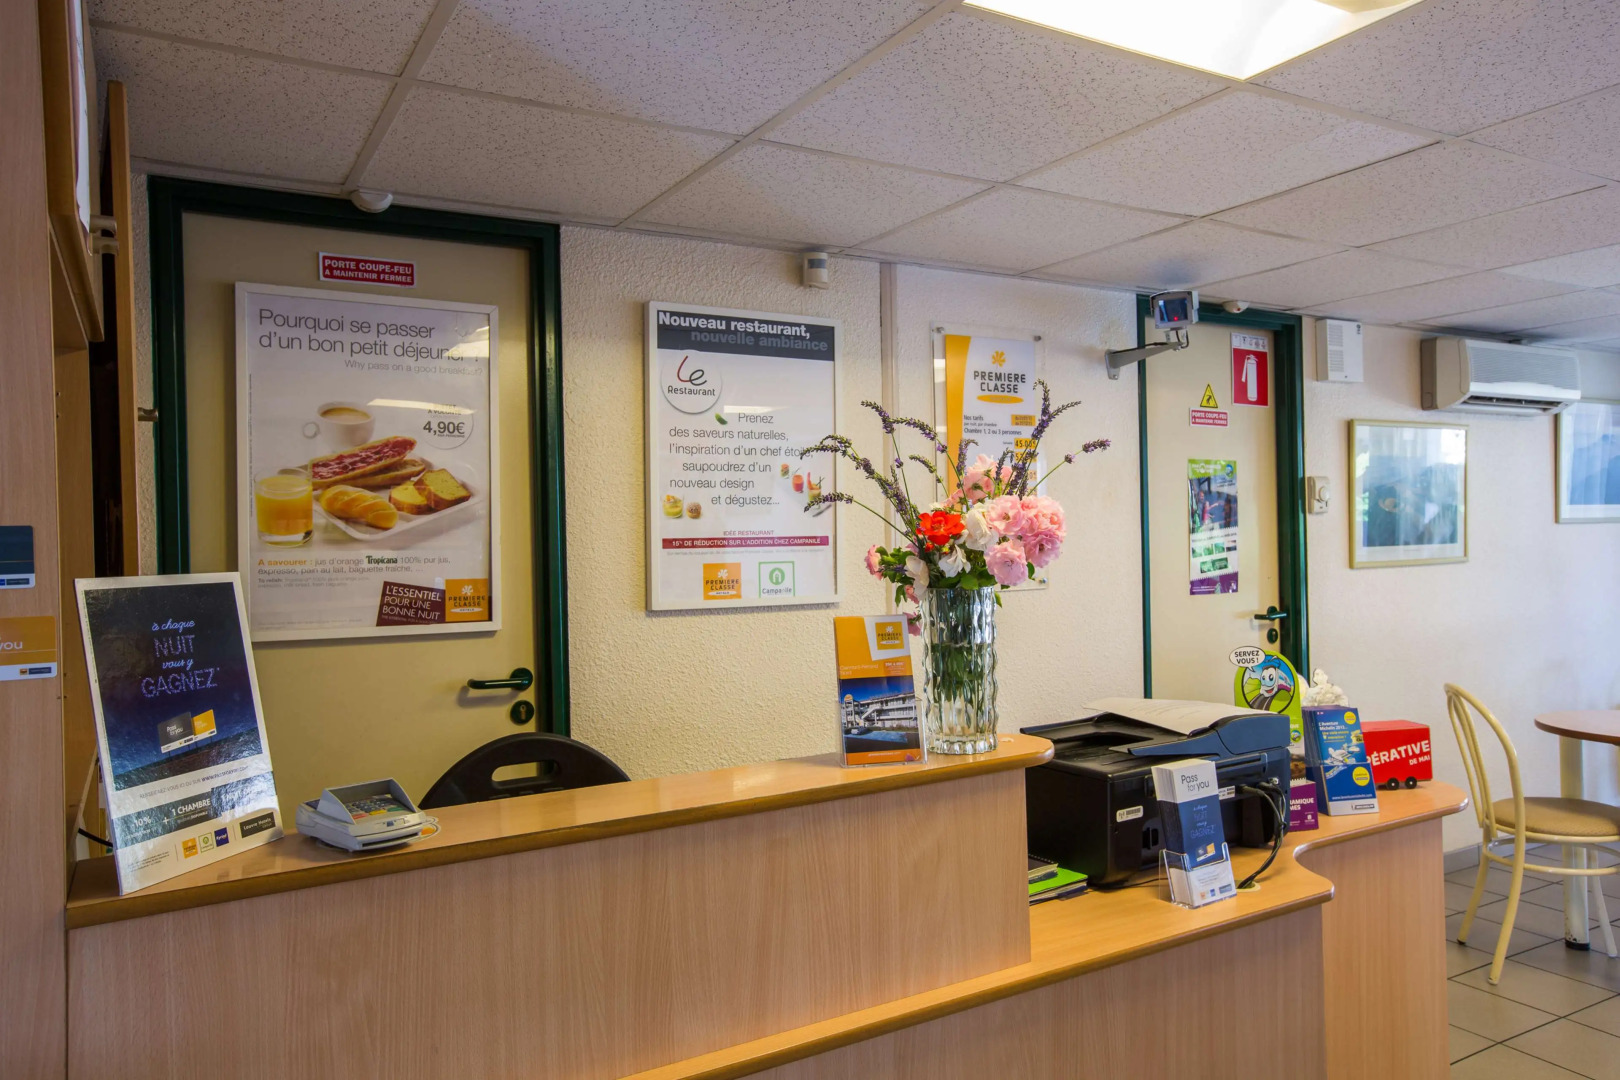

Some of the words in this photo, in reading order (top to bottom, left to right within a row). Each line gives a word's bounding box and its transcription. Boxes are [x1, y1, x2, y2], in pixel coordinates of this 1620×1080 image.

[324, 259, 356, 269] PORTE
[359, 263, 412, 274] COUPE-FEU
[333, 270, 378, 280] MAINTENIR
[258, 308, 344, 334] Pourquoi
[350, 319, 371, 334] se
[376, 322, 435, 339] passer
[658, 312, 726, 330] Nouveau
[730, 320, 810, 340] restaurant,
[258, 332, 302, 350] d'un
[308, 334, 344, 353] bon
[350, 340, 388, 358] petit
[690, 330, 755, 346] nouvelle
[758, 334, 828, 352] ambiance
[344, 360, 366, 372] Why
[368, 362, 389, 374] pass
[392, 364, 404, 372] on
[414, 364, 437, 375] good
[974, 370, 1026, 383] PREMIERE
[667, 385, 716, 396] Restaurant
[980, 382, 1018, 394] CLASSE
[738, 412, 774, 424] Prenez
[423, 420, 465, 436] 4,90€
[669, 426, 690, 438] des
[692, 430, 734, 439] saveurs
[737, 430, 789, 442] naturelles,
[669, 443, 730, 459] l'inspiration
[733, 445, 758, 456] d'un
[760, 446, 782, 456] chef
[682, 461, 746, 474] saupoudrez
[748, 462, 772, 473] d'un
[669, 478, 716, 488] nouveau
[720, 477, 754, 491] design
[711, 496, 722, 505] et
[725, 494, 780, 508] dégustez...
[694, 538, 728, 546] RÉDUCTION
[314, 558, 327, 567] jus
[328, 558, 364, 567] d'orange
[366, 555, 398, 565] Tropicana
[424, 557, 436, 565] pur
[438, 556, 451, 565] jus,
[258, 568, 298, 576] expresso,
[300, 567, 318, 575] pain
[332, 566, 346, 574] lait,
[349, 566, 384, 577] baguette
[386, 585, 442, 602] L'ESSENTIEL
[384, 596, 410, 607] POUR
[412, 600, 431, 610] UNE
[382, 606, 416, 618] BONNE
[417, 611, 440, 620] NUIT
[152, 620, 160, 631] à
[161, 618, 196, 633] chaque
[153, 634, 196, 658] NUIT
[162, 659, 186, 670] vous
[186, 659, 194, 671] y
[141, 668, 218, 698] GAGNEZ
[1409, 758, 1418, 766] DE
[1181, 775, 1198, 784] Pass
[1196, 780, 1210, 792] you
[177, 798, 211, 814] CHAMBRE
